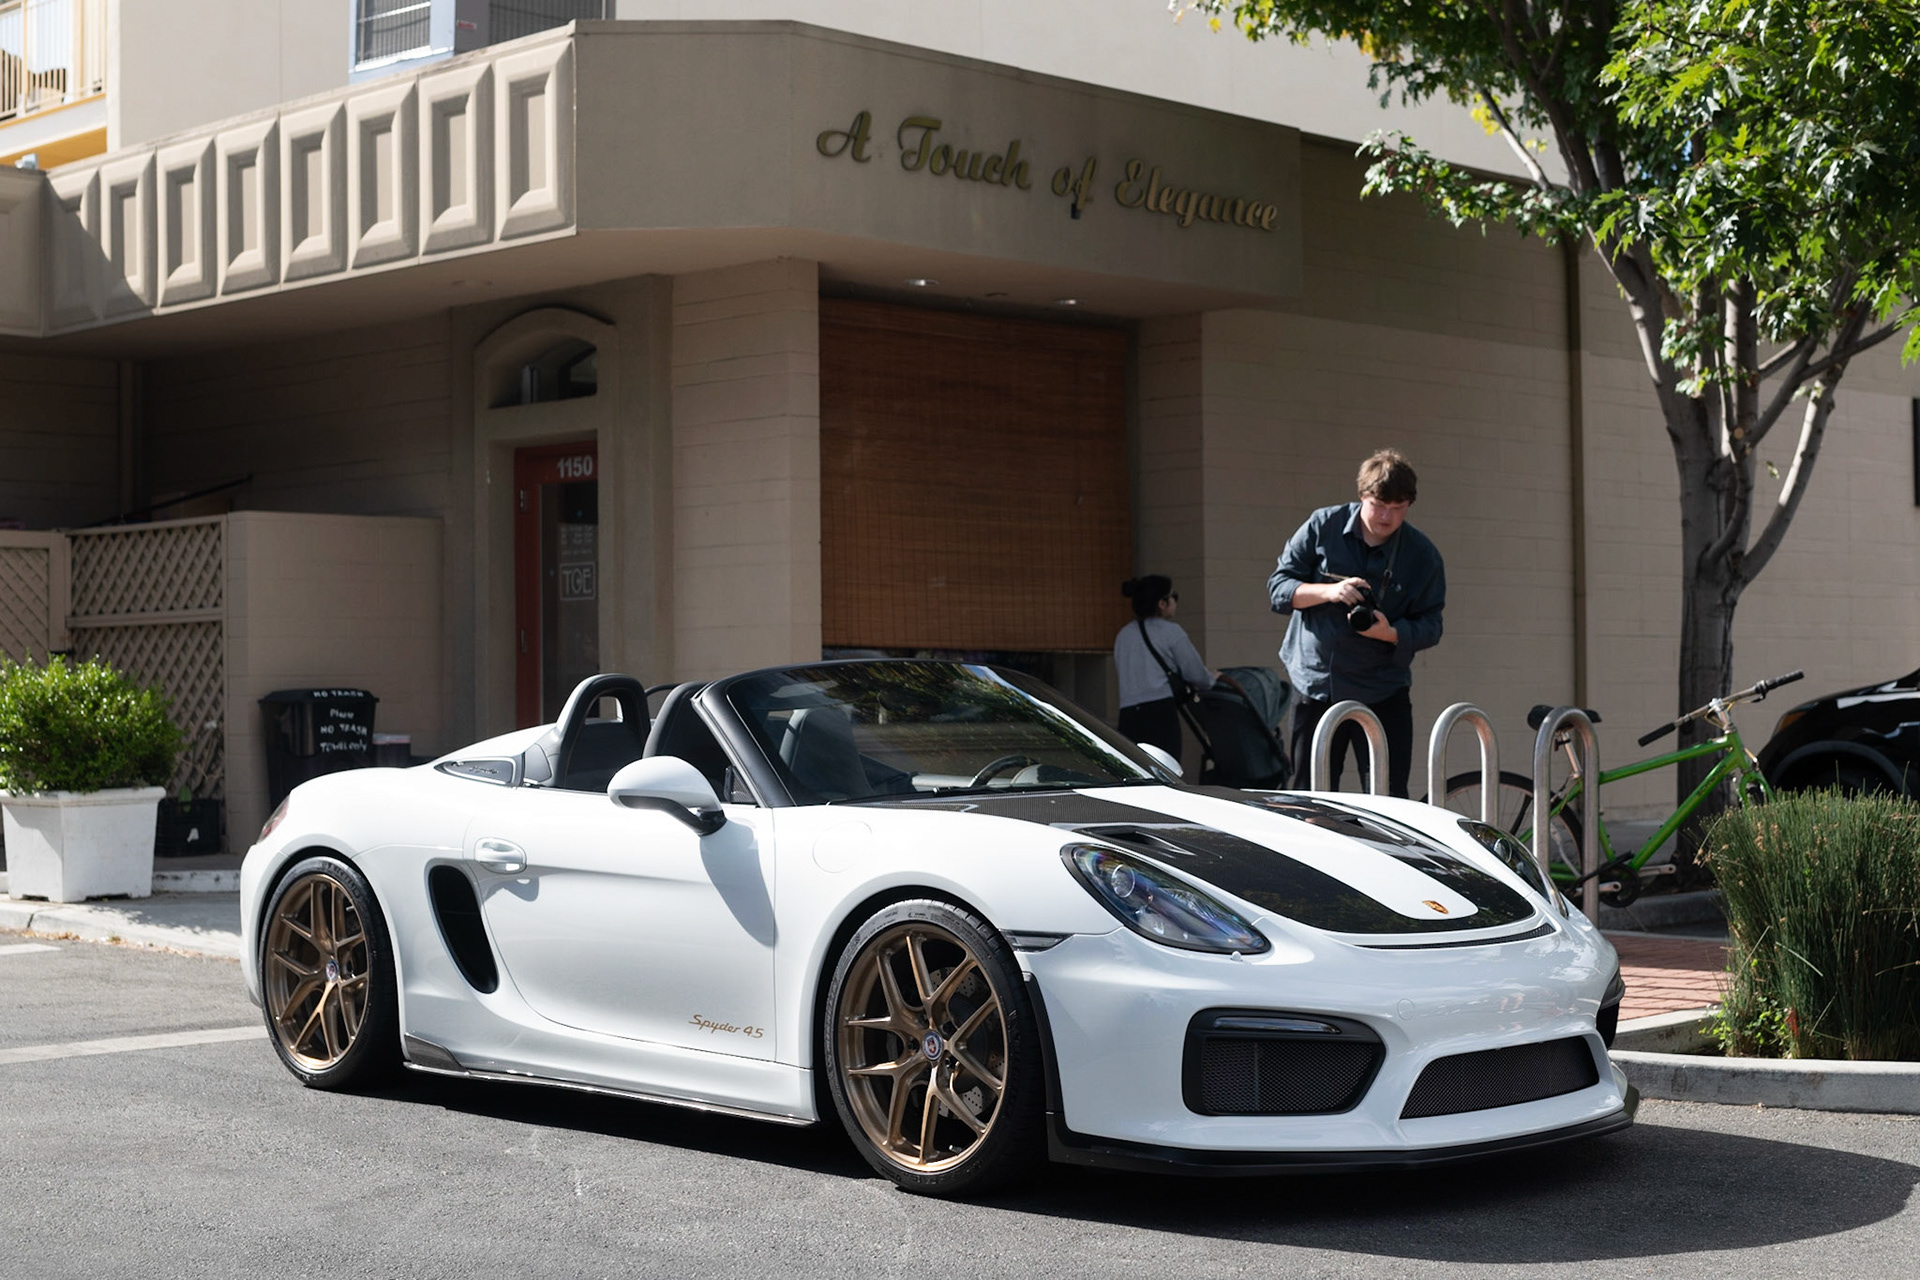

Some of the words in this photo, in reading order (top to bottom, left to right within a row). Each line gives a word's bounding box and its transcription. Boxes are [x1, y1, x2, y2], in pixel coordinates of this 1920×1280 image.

[815, 110, 871, 163] A
[897, 115, 1031, 190] Touch
[1051, 156, 1096, 210] of
[1114, 159, 1280, 231] Elegance
[557, 456, 593, 478] 1150
[320, 725, 334, 734] NO
[339, 723, 367, 736] TRASH
[688, 1014, 741, 1034] Spyder
